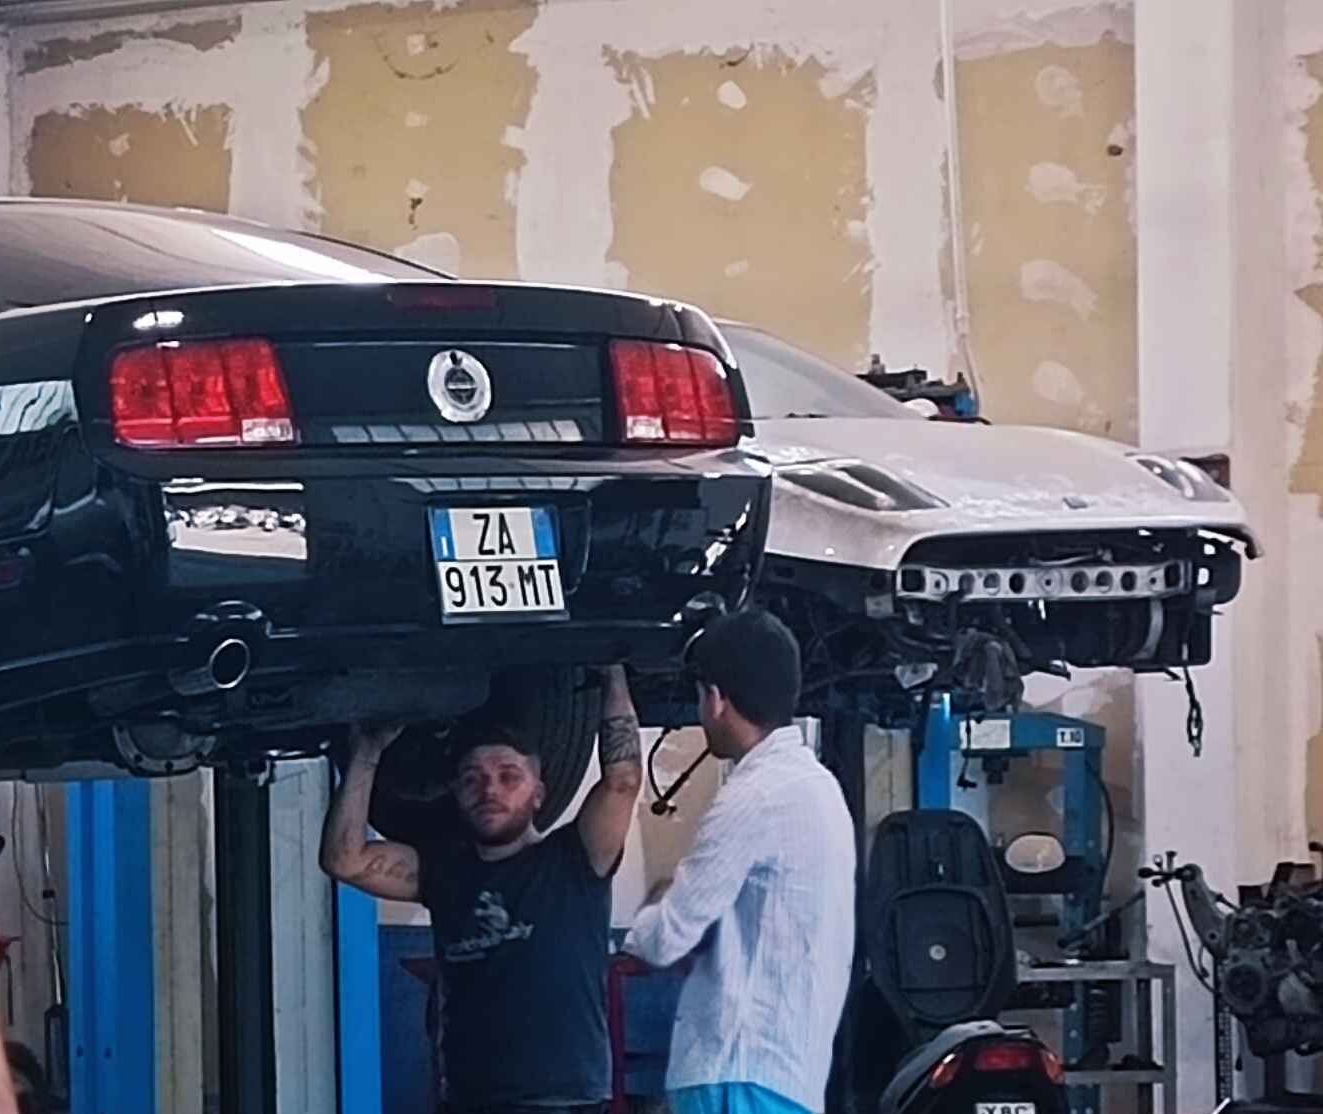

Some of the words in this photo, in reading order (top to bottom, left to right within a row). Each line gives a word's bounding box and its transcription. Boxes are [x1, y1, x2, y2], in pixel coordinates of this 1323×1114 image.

[472, 512, 516, 556] ZA
[445, 565, 508, 608] 913
[516, 564, 555, 606] MT
